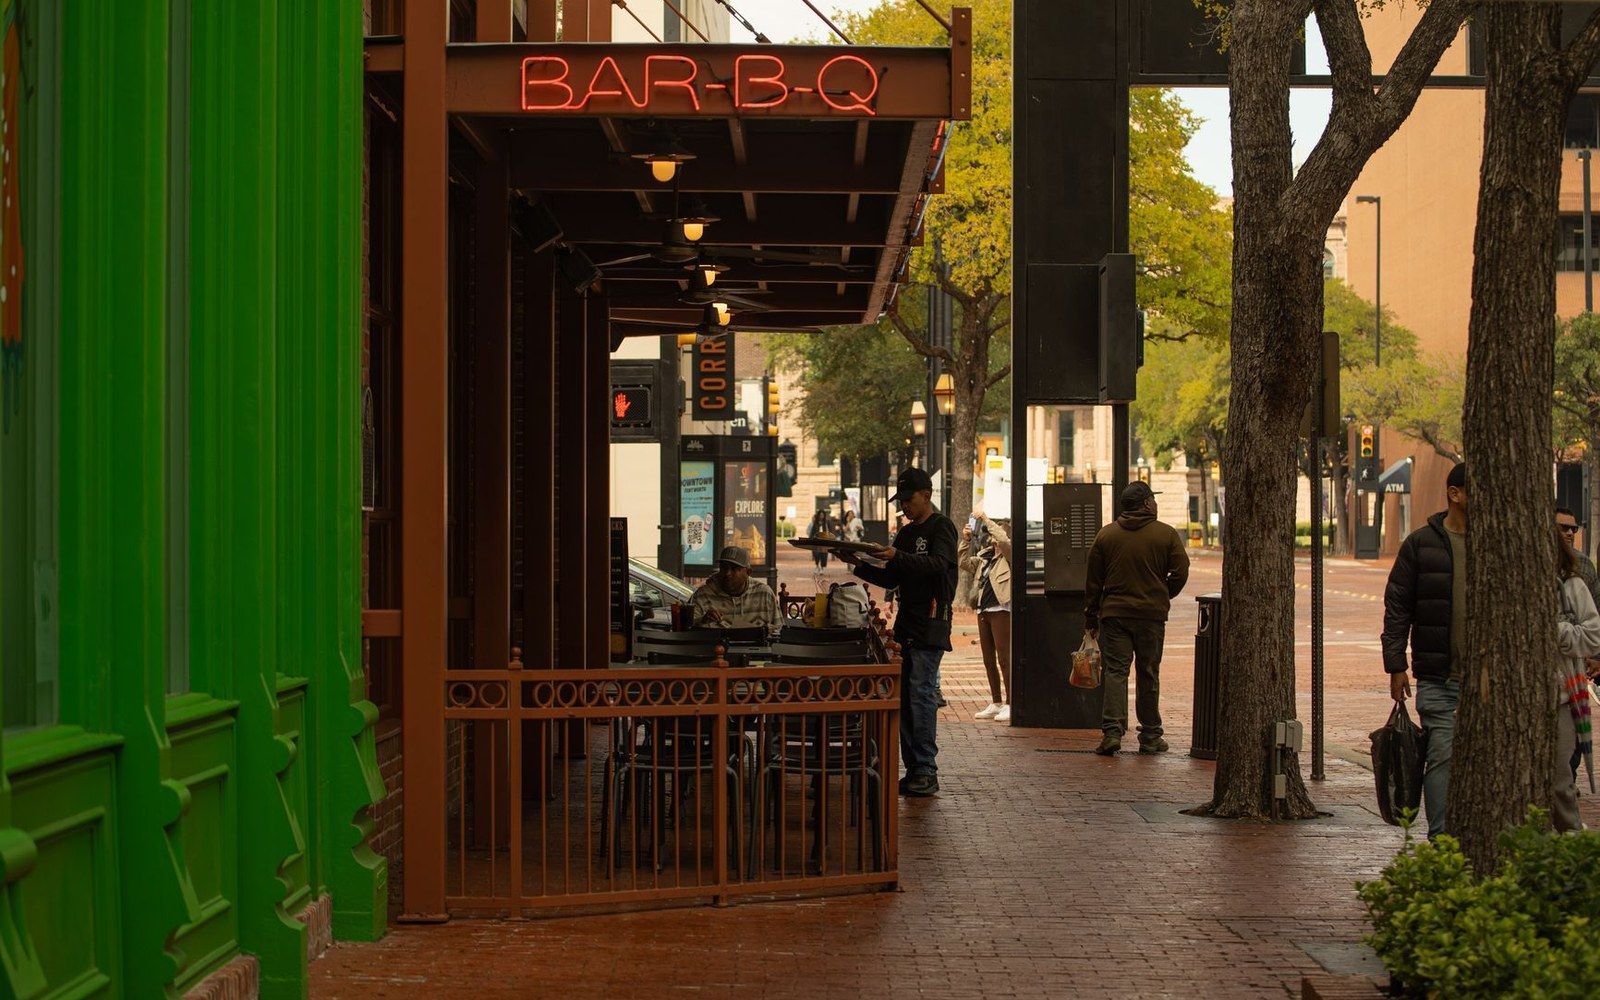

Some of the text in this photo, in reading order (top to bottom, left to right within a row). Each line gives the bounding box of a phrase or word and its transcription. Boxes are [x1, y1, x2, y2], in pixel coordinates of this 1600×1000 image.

[520, 54, 879, 116] BAR-B-Q
[1385, 483, 1404, 492] ATM
[735, 500, 765, 514] EXPLORE
